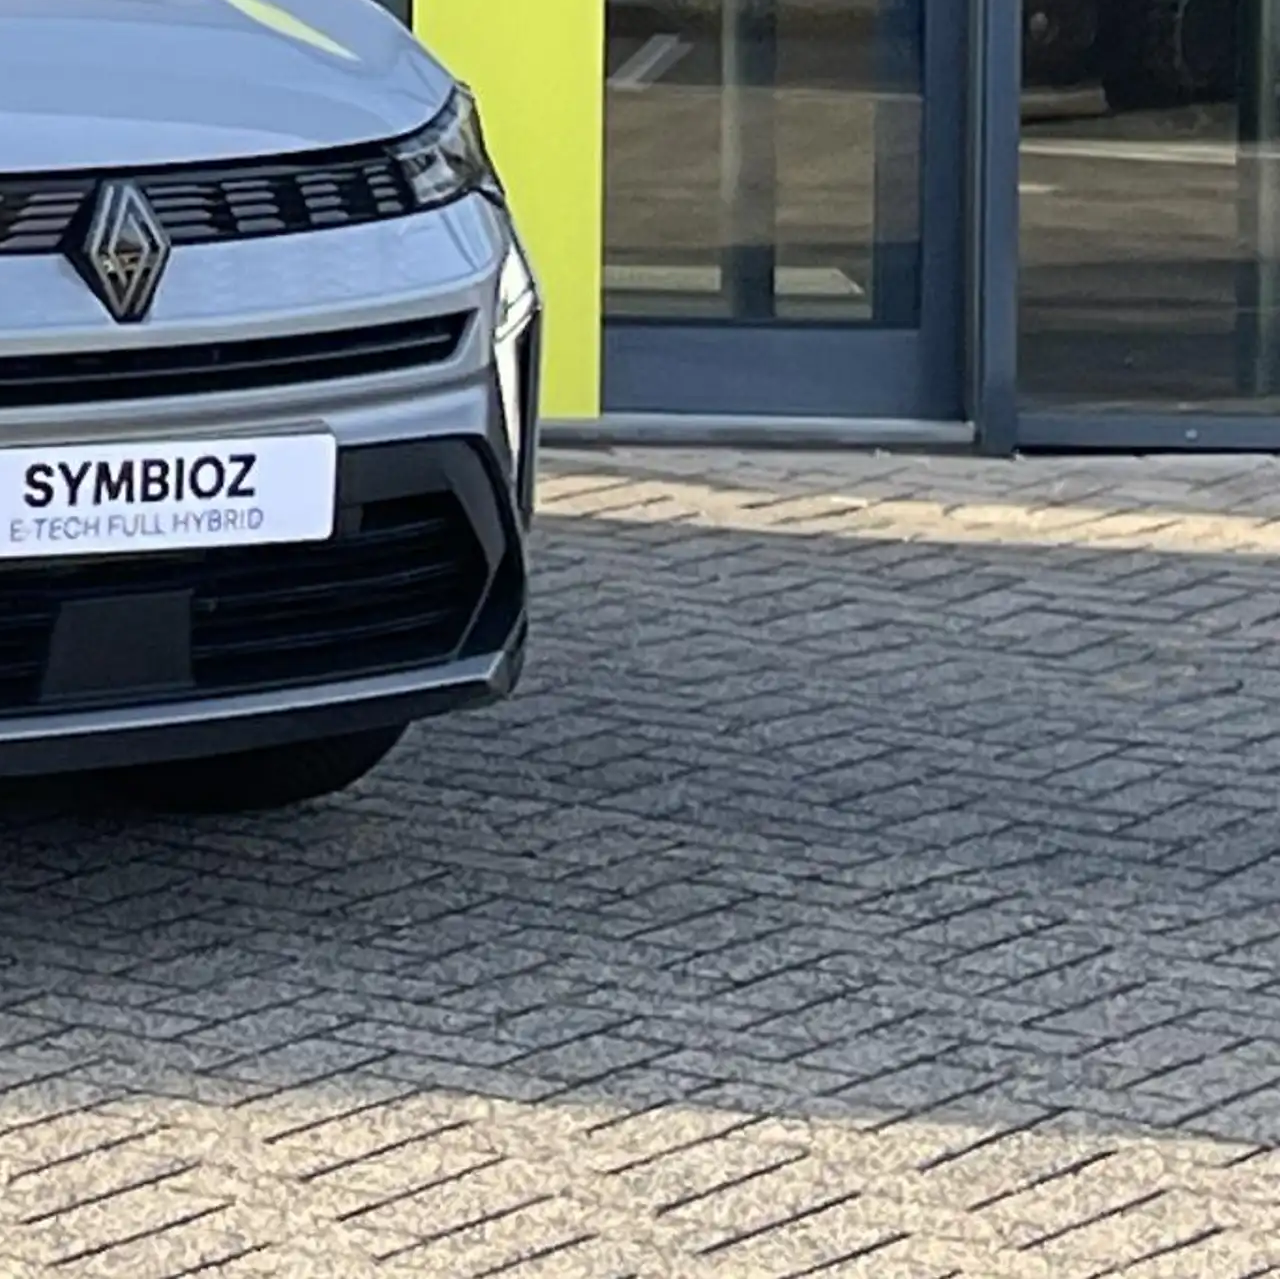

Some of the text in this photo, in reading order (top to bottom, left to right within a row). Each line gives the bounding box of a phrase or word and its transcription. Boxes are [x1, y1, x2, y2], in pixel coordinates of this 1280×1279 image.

[23, 453, 258, 508] SYMBIOZ
[107, 512, 165, 538] FULL
[172, 508, 264, 535] HYBRID
